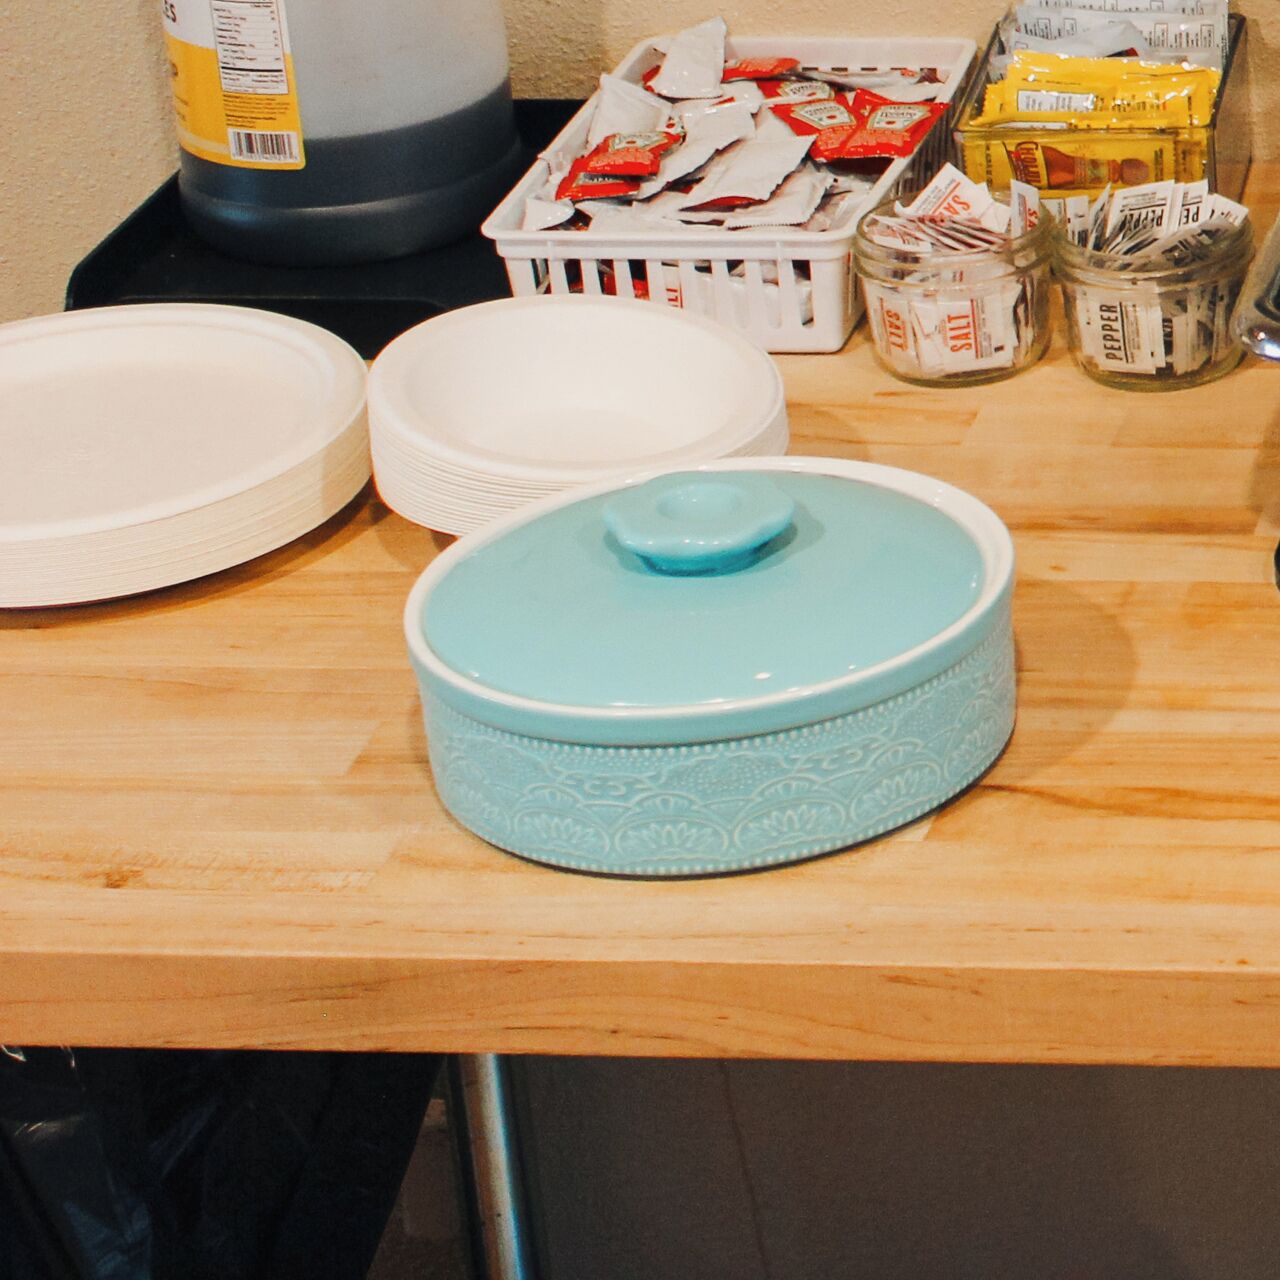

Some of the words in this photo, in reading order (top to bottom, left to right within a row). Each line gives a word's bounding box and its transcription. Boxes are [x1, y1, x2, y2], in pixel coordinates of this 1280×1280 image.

[1015, 141, 1041, 184] CHOLUL
[886, 310, 905, 350] SALT
[947, 314, 972, 353] SALT
[1100, 304, 1123, 361] PEPPER
